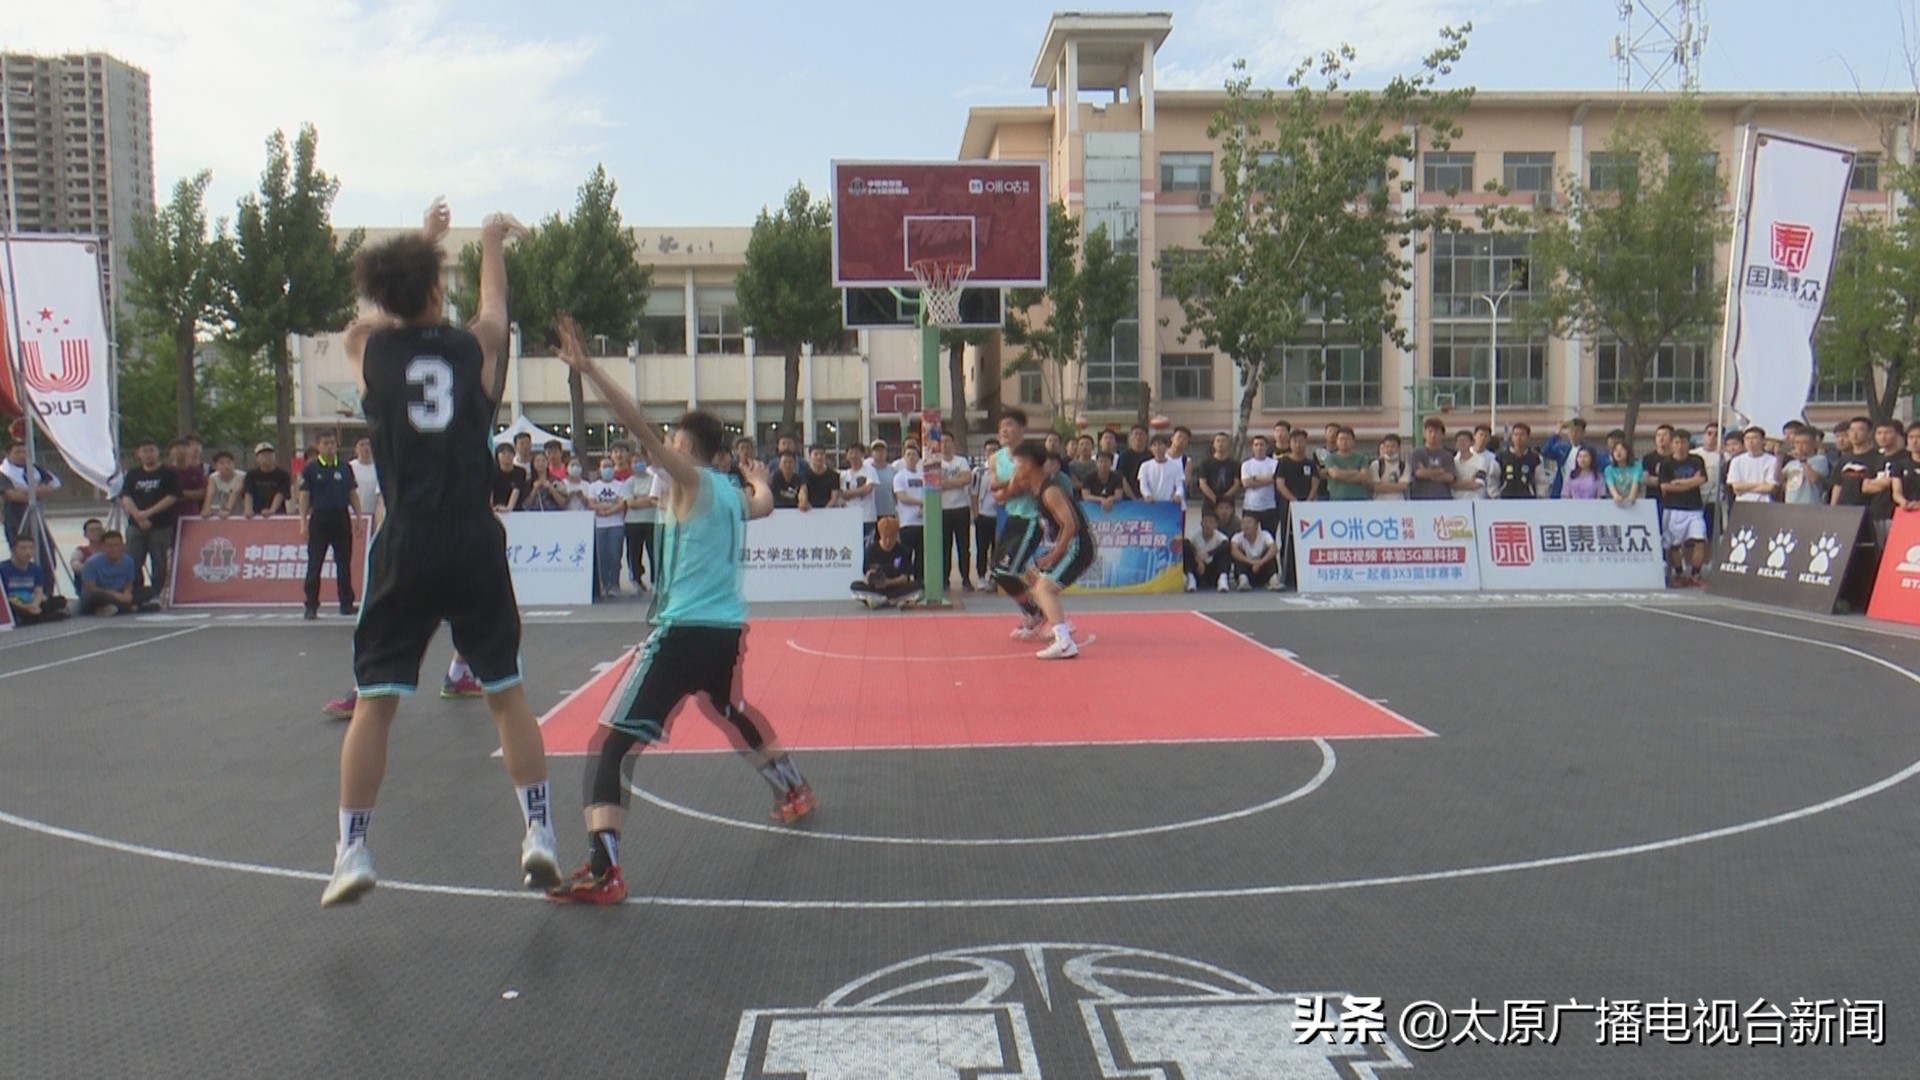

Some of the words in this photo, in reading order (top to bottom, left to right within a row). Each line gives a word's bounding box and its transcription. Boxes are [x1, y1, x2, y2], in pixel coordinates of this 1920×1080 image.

[405, 355, 455, 433] 3
[1330, 516, 1398, 541] 咪咕
[1540, 524, 1652, 553] 国泰慧众
[1315, 550, 1378, 563] 上咪咕视频
[1382, 550, 1459, 563] 体验5G黑科技
[1720, 562, 1748, 575] KELME
[1757, 567, 1788, 580] KELME
[1799, 572, 1832, 586] KELME
